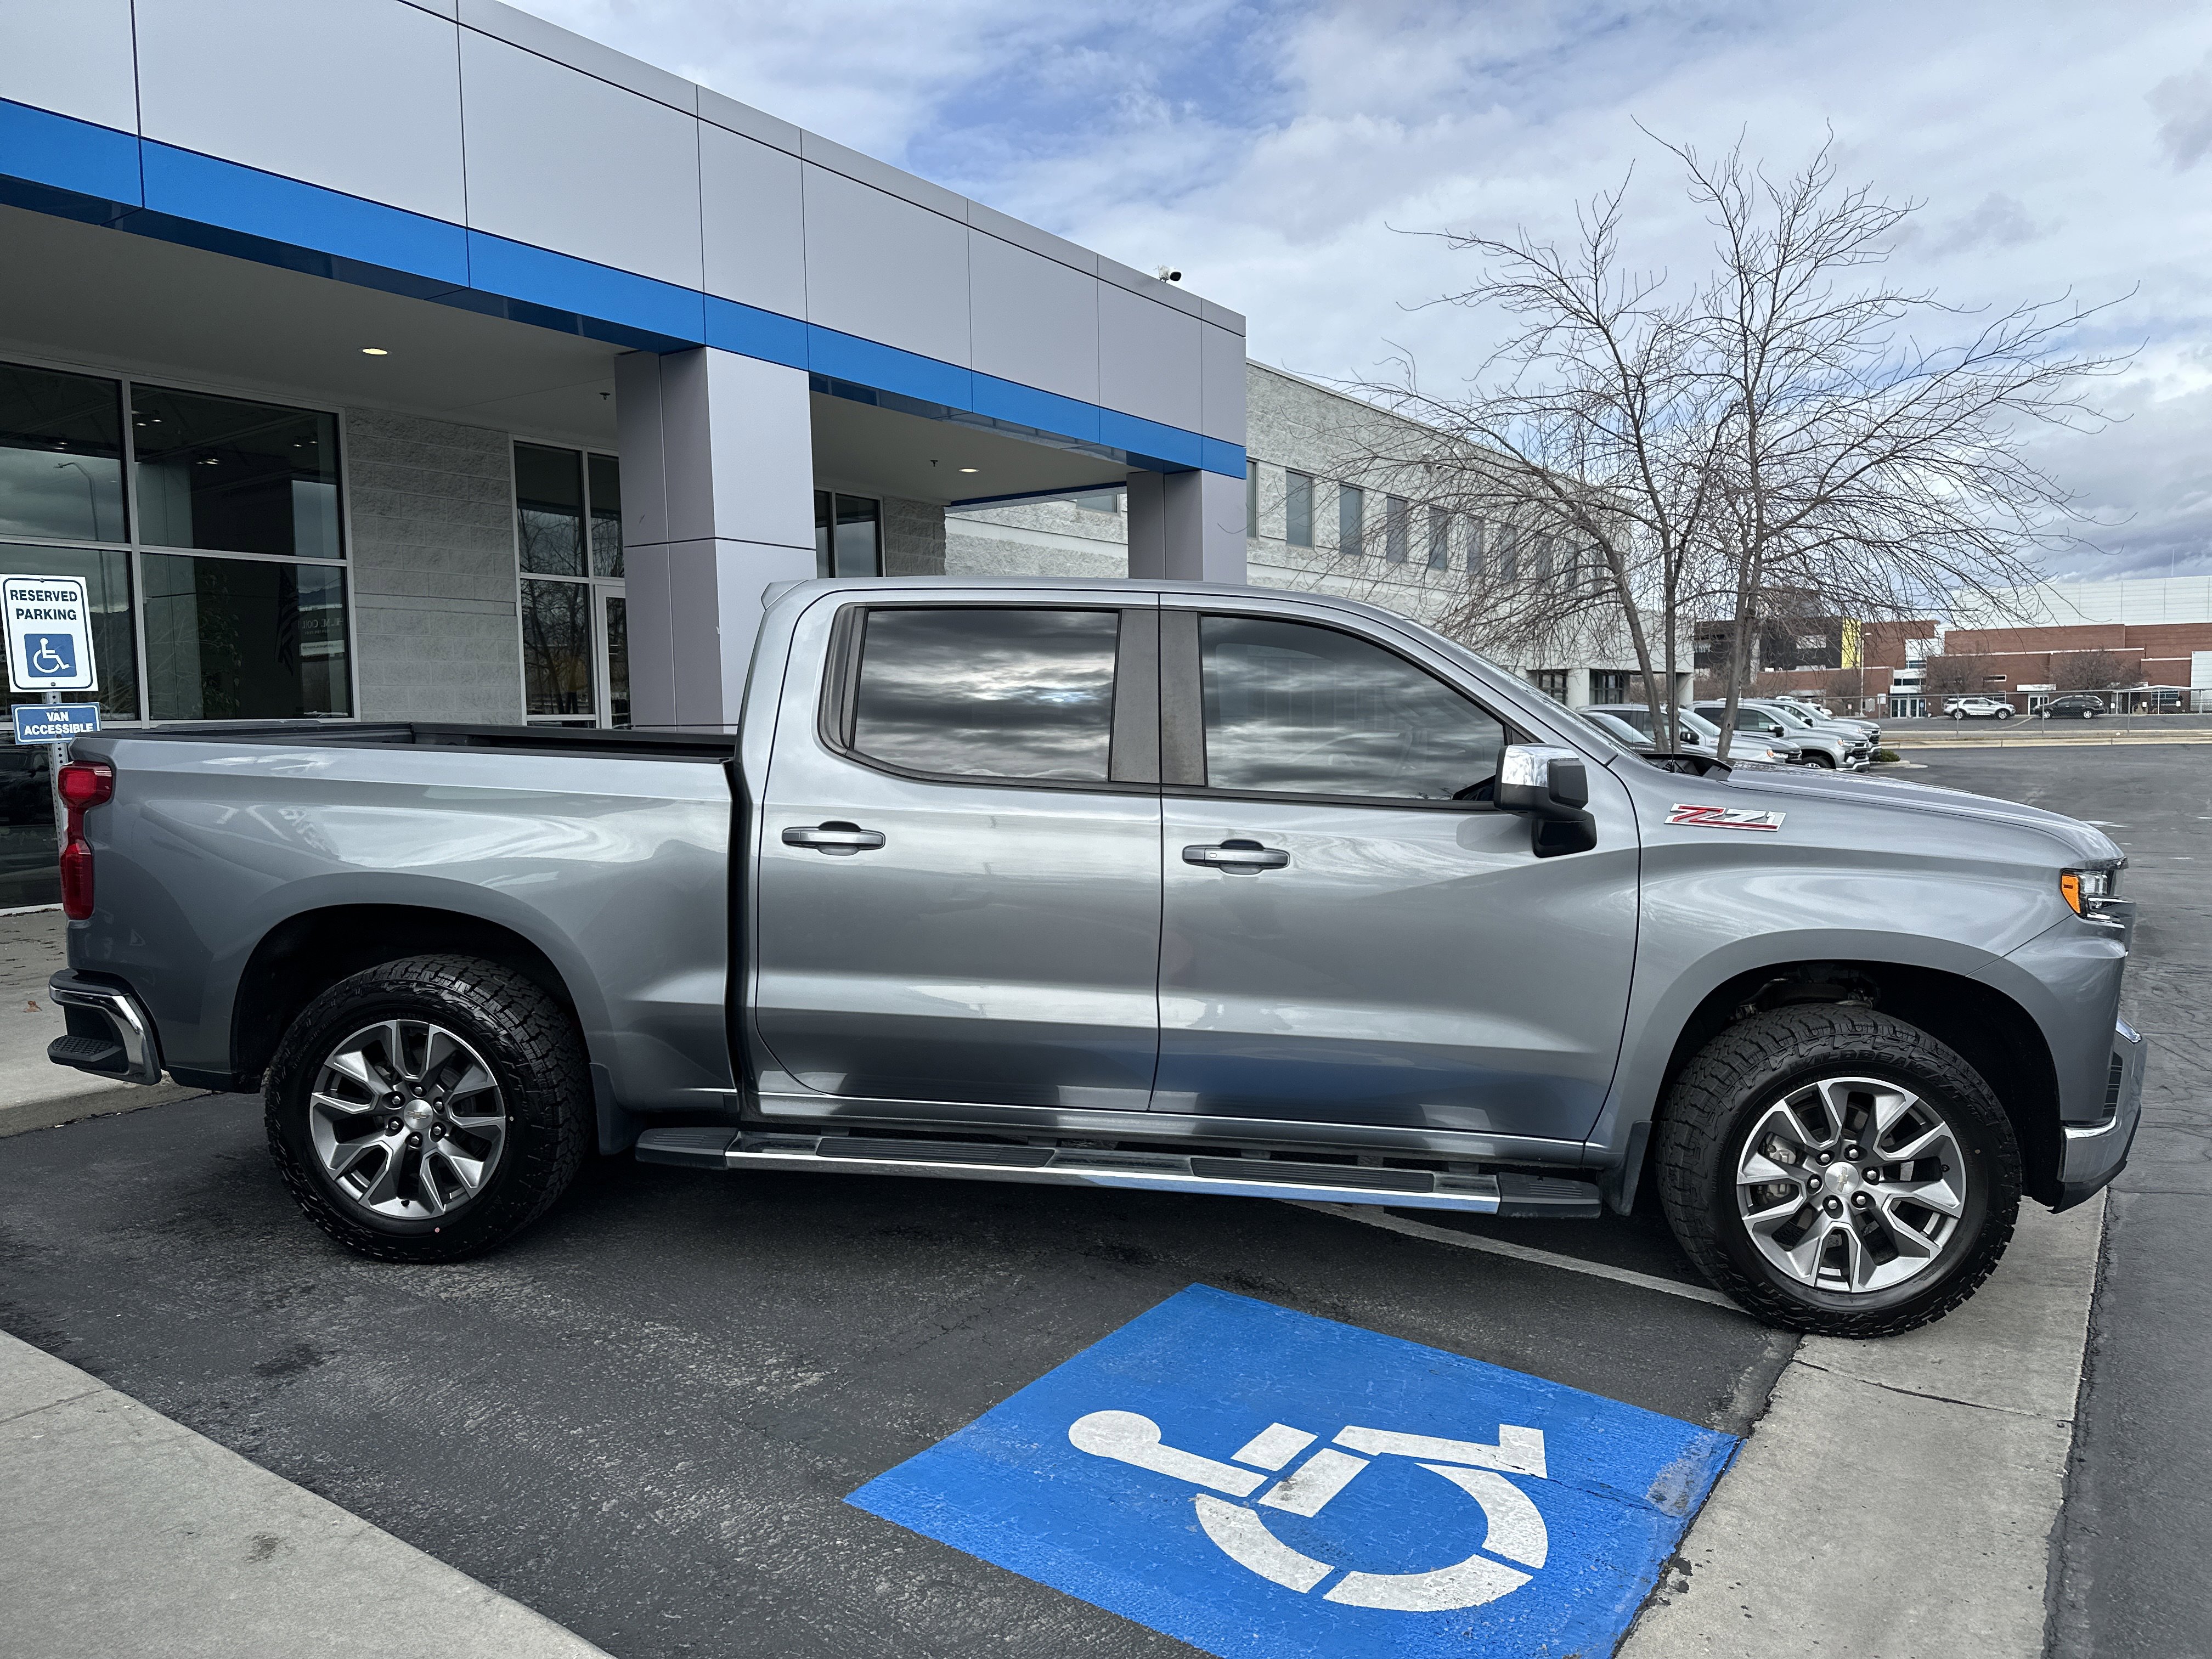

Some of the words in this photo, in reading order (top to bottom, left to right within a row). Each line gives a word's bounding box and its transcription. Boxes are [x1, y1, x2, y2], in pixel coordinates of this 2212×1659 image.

[10, 589, 77, 602] RESERVED
[16, 608, 77, 620] PARKING
[46, 712, 69, 722] VAN
[24, 723, 94, 736] ACCESSIBLE
[1664, 803, 1786, 832] Z71
